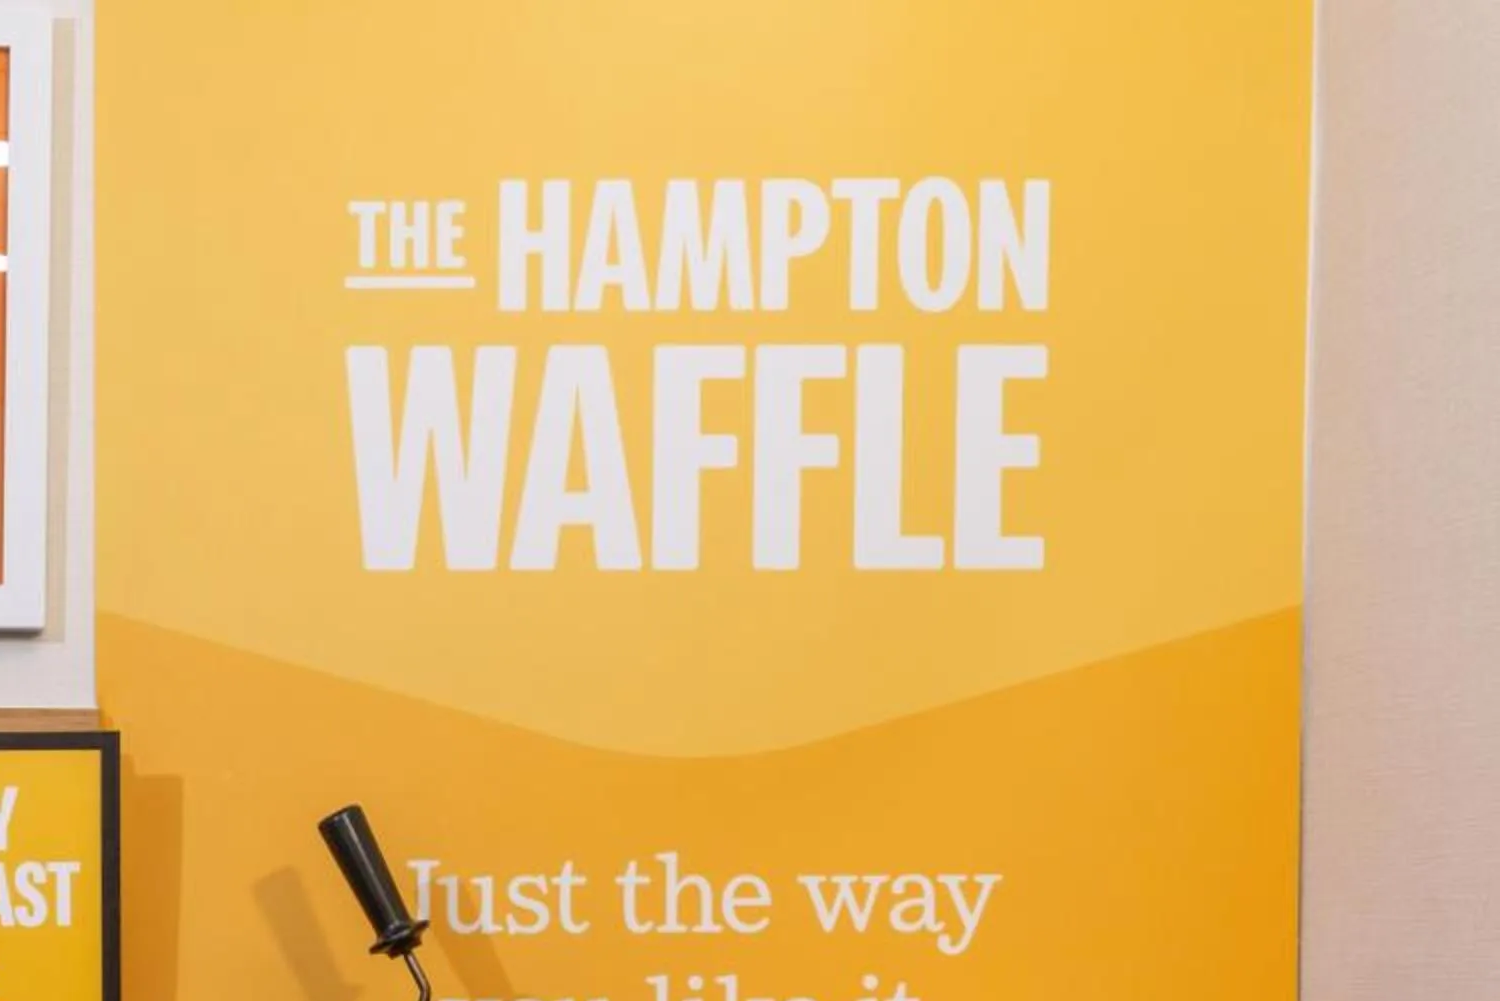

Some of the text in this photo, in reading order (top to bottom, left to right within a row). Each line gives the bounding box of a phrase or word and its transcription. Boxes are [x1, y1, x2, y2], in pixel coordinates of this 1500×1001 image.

[349, 176, 1050, 312] THE HAMPTON
[344, 343, 1048, 571] WAFFLE
[407, 852, 1003, 955] Just the way
